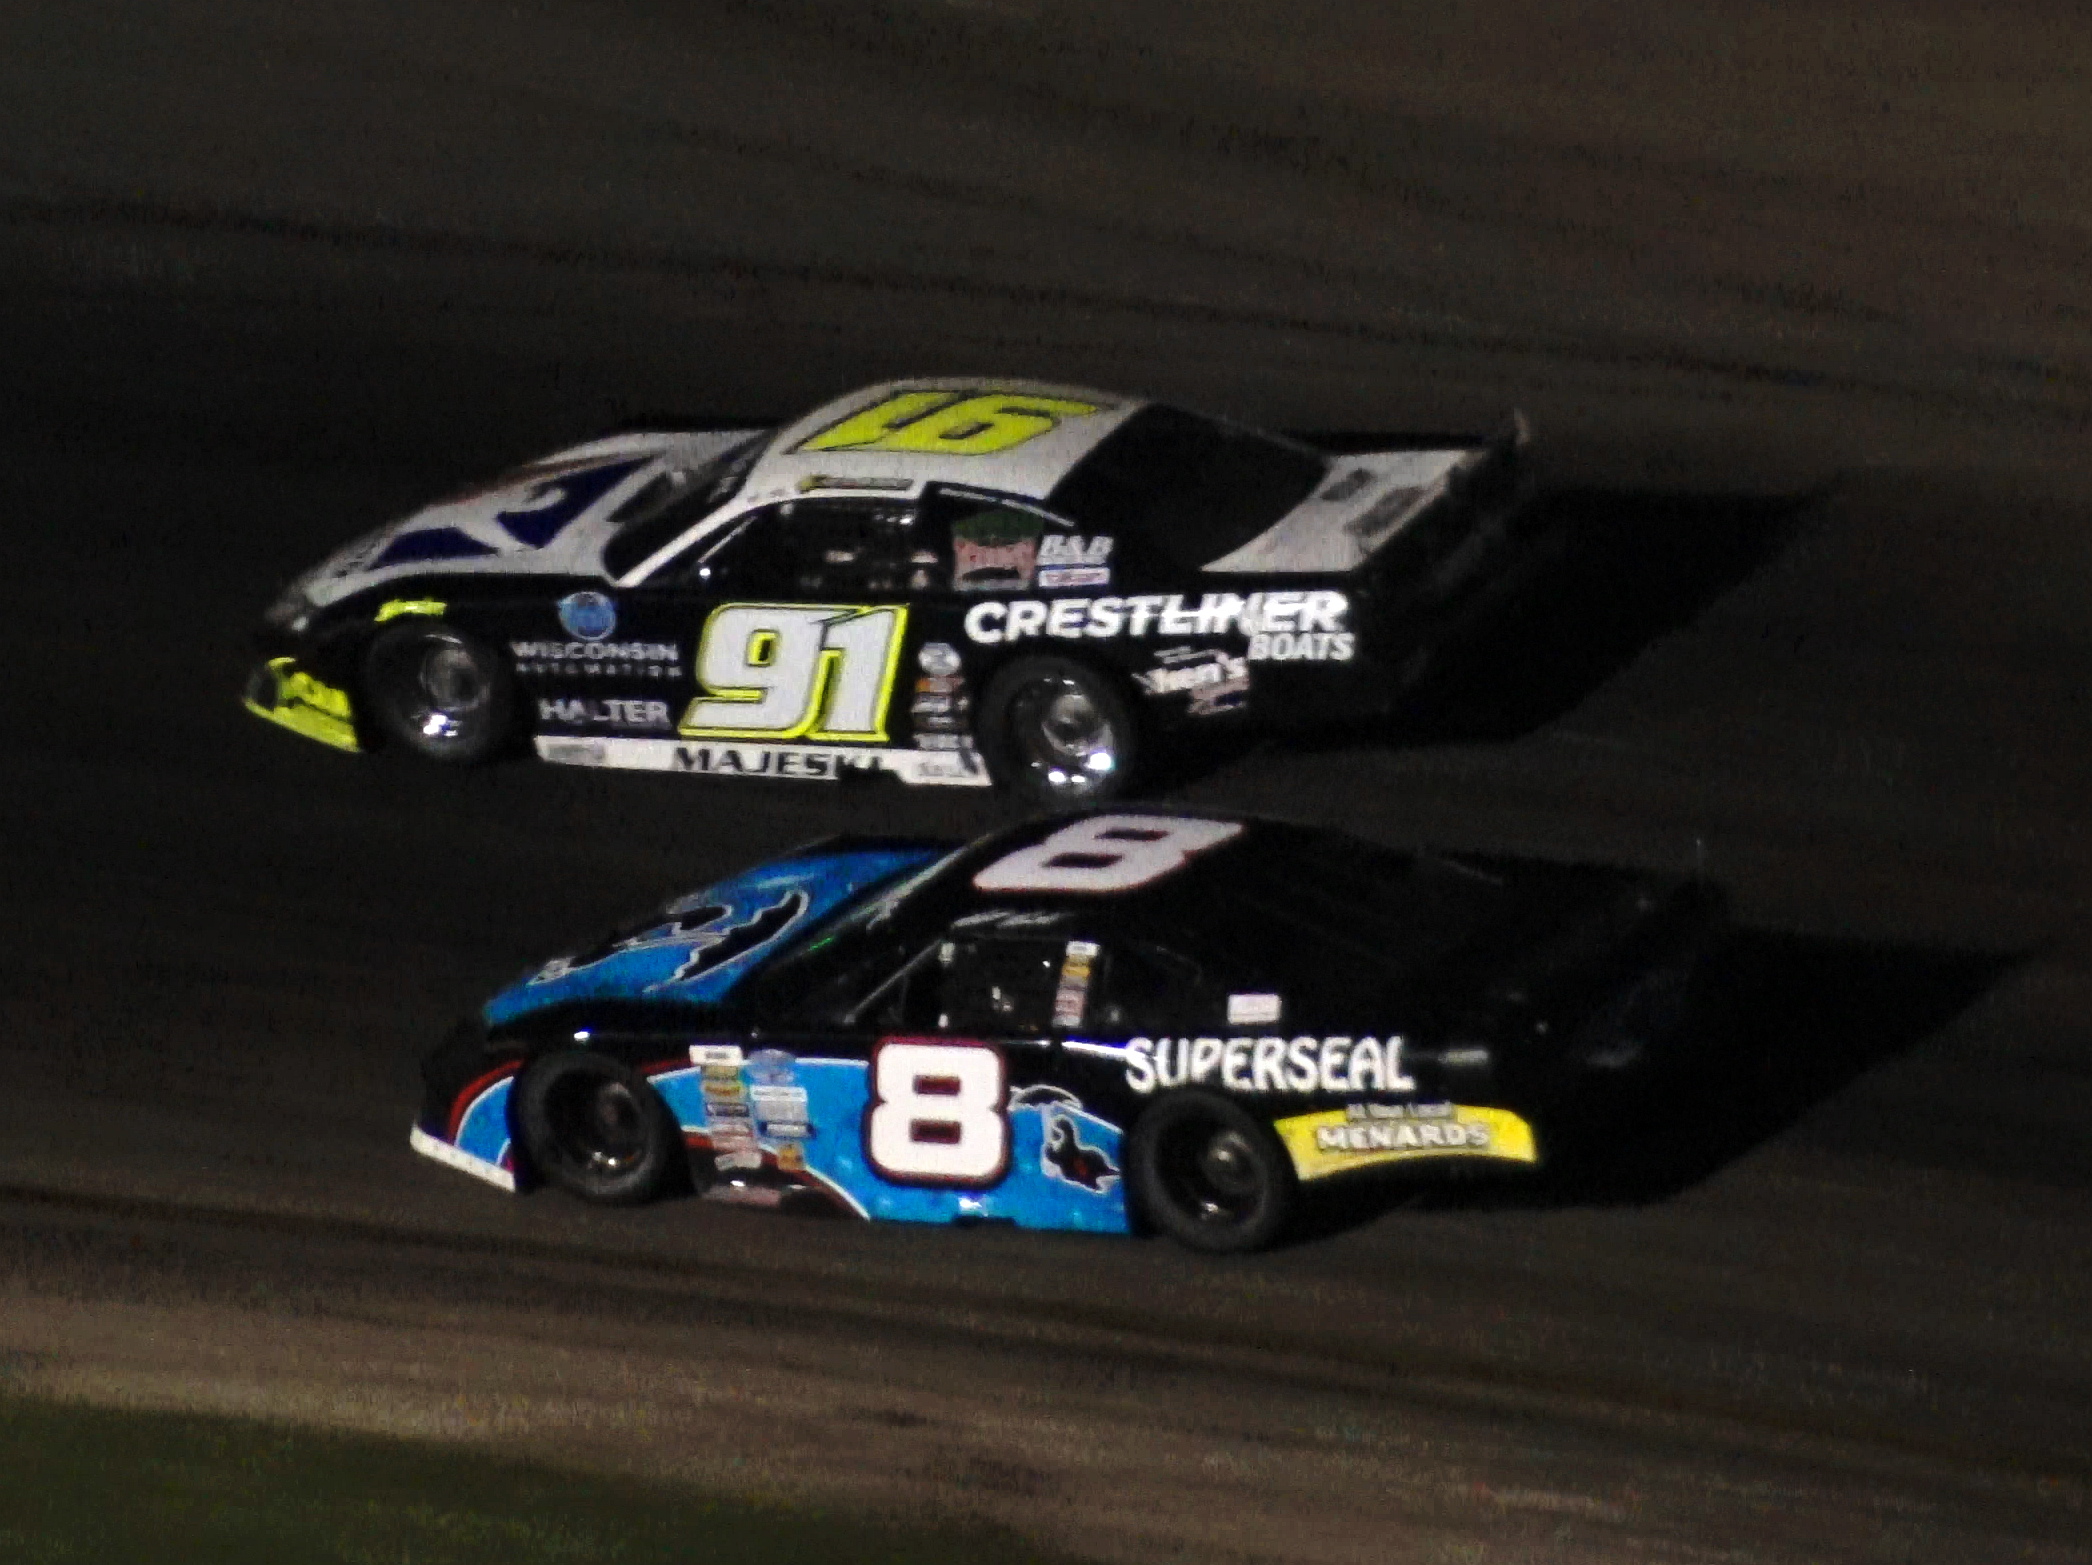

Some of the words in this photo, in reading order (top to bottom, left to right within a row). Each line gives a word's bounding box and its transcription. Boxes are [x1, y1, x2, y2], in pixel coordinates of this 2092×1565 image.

[964, 591, 1349, 643] CRESTLINER
[511, 641, 678, 660] WISCONSIN
[677, 602, 908, 743] 91
[1247, 632, 1355, 661] BOATS
[538, 699, 671, 726] HALTER
[972, 814, 1243, 892] 8
[1125, 1035, 1416, 1093] SUPERSEAL
[869, 1037, 1010, 1187] 8
[1317, 1122, 1490, 1150] MENARDS
